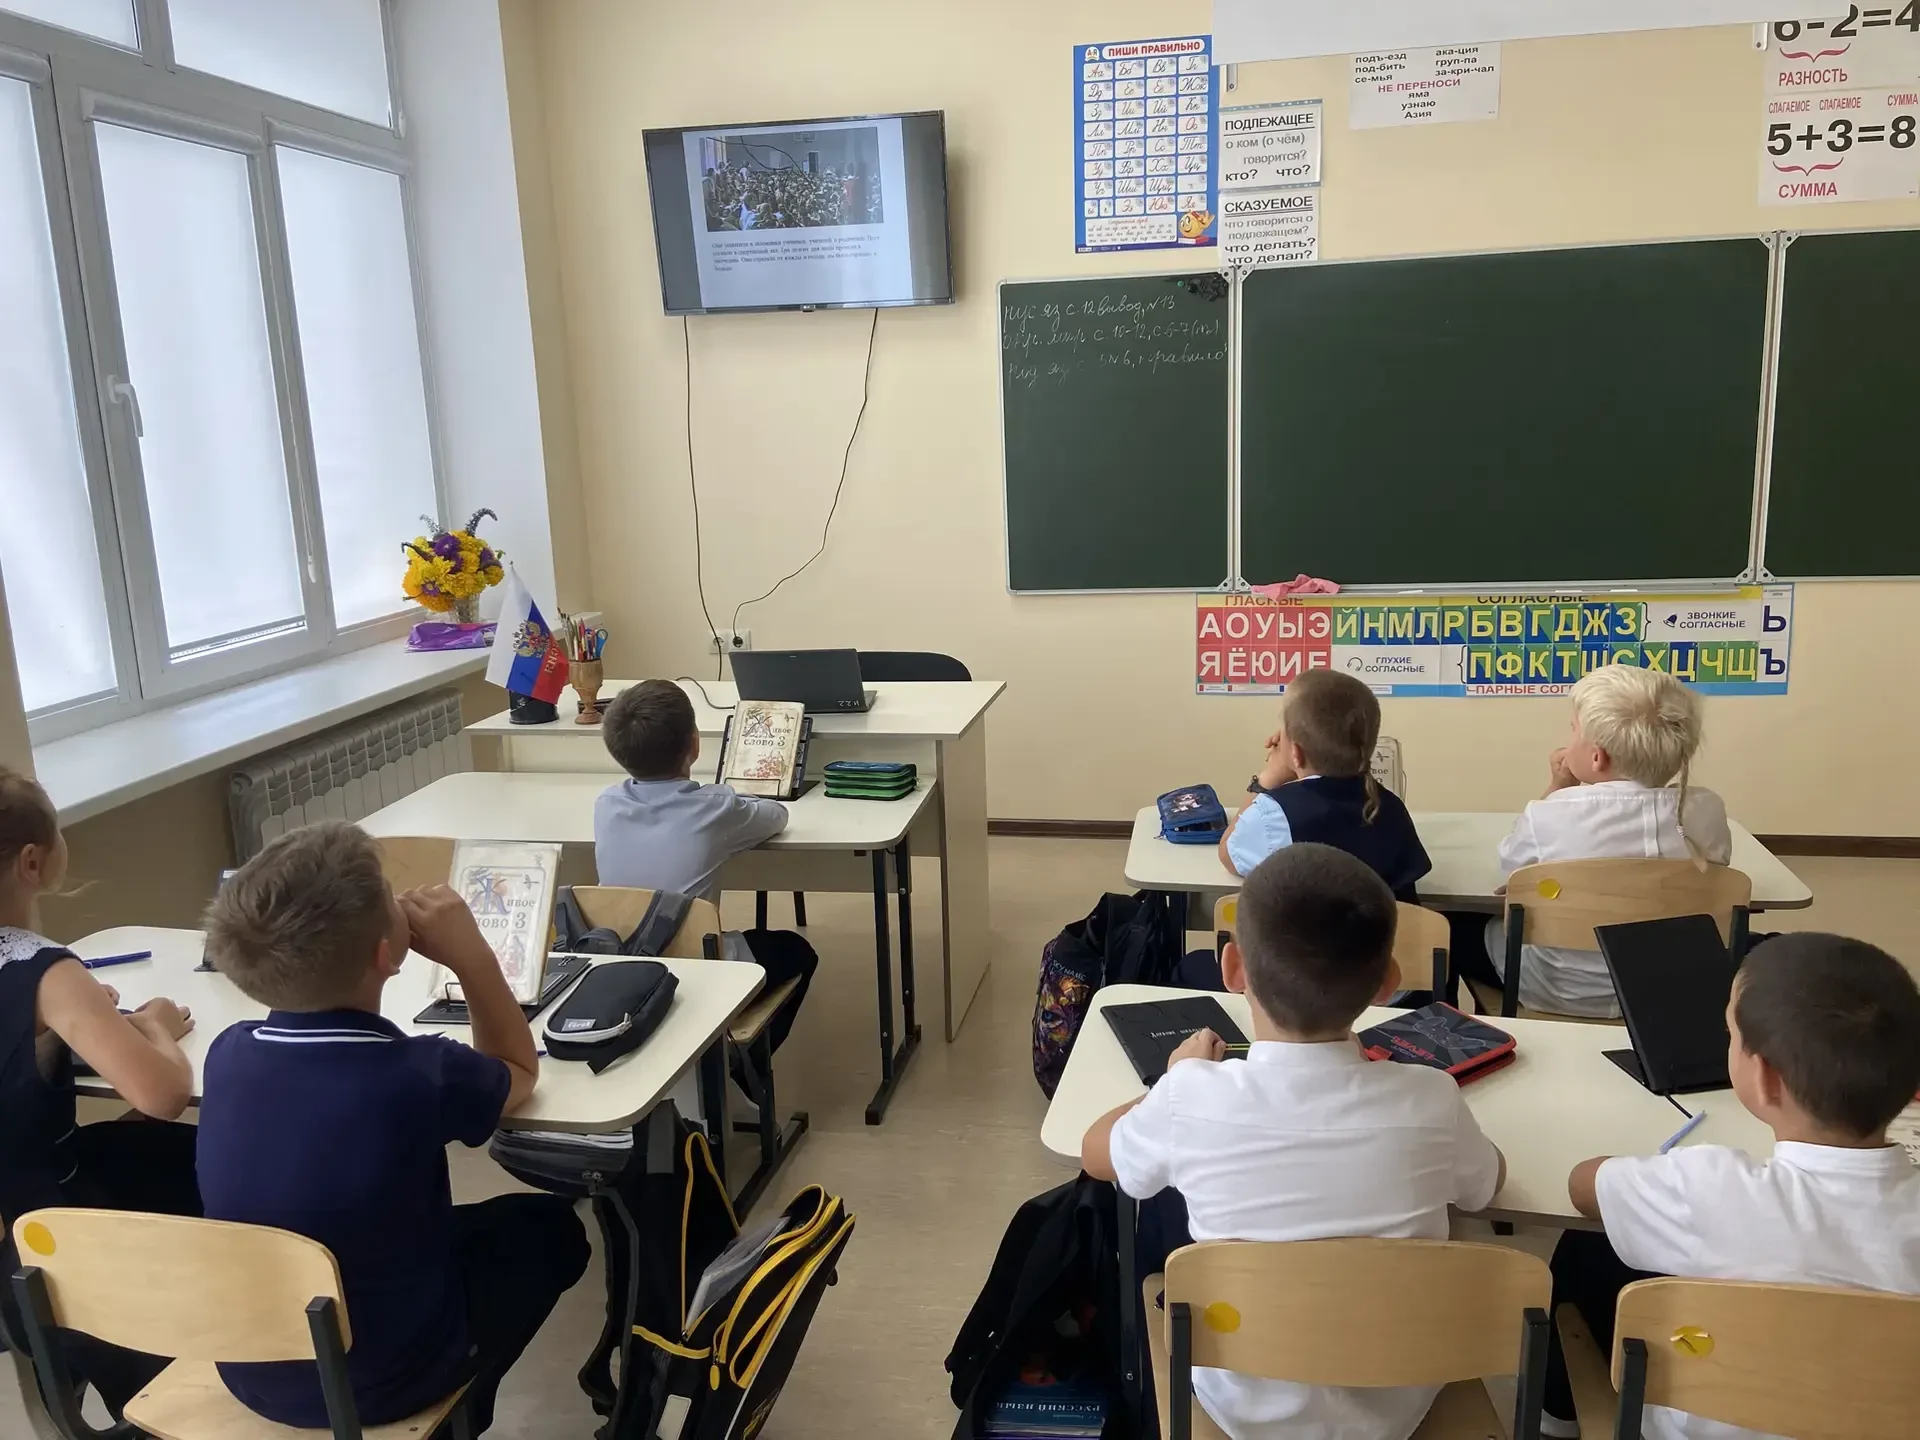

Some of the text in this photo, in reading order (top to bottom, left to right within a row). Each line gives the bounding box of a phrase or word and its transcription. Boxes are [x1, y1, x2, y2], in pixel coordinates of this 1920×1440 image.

[1108, 42, 1201, 57] ПИШИ ПРАВИЛЬНО
[1435, 47, 1479, 56] ака-ция
[1355, 52, 1407, 64] подъ-езд
[1435, 57, 1478, 67] груп-па
[1355, 63, 1406, 74] под-бить
[1435, 65, 1495, 76] за-кри-чал
[1355, 74, 1393, 84] се-мья
[1779, 69, 1848, 86] РАЗНОСТЬ
[1378, 79, 1461, 93] НЕ ПЕРЕНОСИ
[1408, 91, 1430, 99] яма
[1401, 100, 1436, 111] узнаю
[1769, 94, 1919, 114] СЛАГАЕМОЕ СЛАГАЕМОЕ СУММА
[1225, 113, 1314, 130] ПОДЛЕЖАЩЕЕ
[1404, 111, 1432, 119] Азия
[1226, 132, 1305, 149] о ком (о чём)
[1243, 149, 1307, 165] говорится?
[1225, 164, 1311, 181] кто? что?
[1778, 182, 1838, 198] СУММА
[1224, 196, 1313, 213] СКАЗУЕМОЕ
[1225, 221, 1244, 229] что
[1247, 216, 1303, 227] говорится
[1228, 226, 1309, 240] подлежащем?
[1225, 237, 1316, 253] что делать?
[1228, 250, 1313, 264] что делал?
[1687, 611, 1736, 620] ЗВОНКИЕ
[1763, 605, 1787, 632] Ь
[1679, 620, 1746, 629] СОГЛАСНЫЕ
[1376, 656, 1412, 664] ГЛУХИЕ
[1760, 648, 1786, 675] Ъ
[1365, 665, 1425, 673] СОГЛАСНЫЕ
[1475, 685, 1536, 694] ПАРНЫЕ
[777, 736, 785, 746] 3
[515, 911, 526, 929] 3
